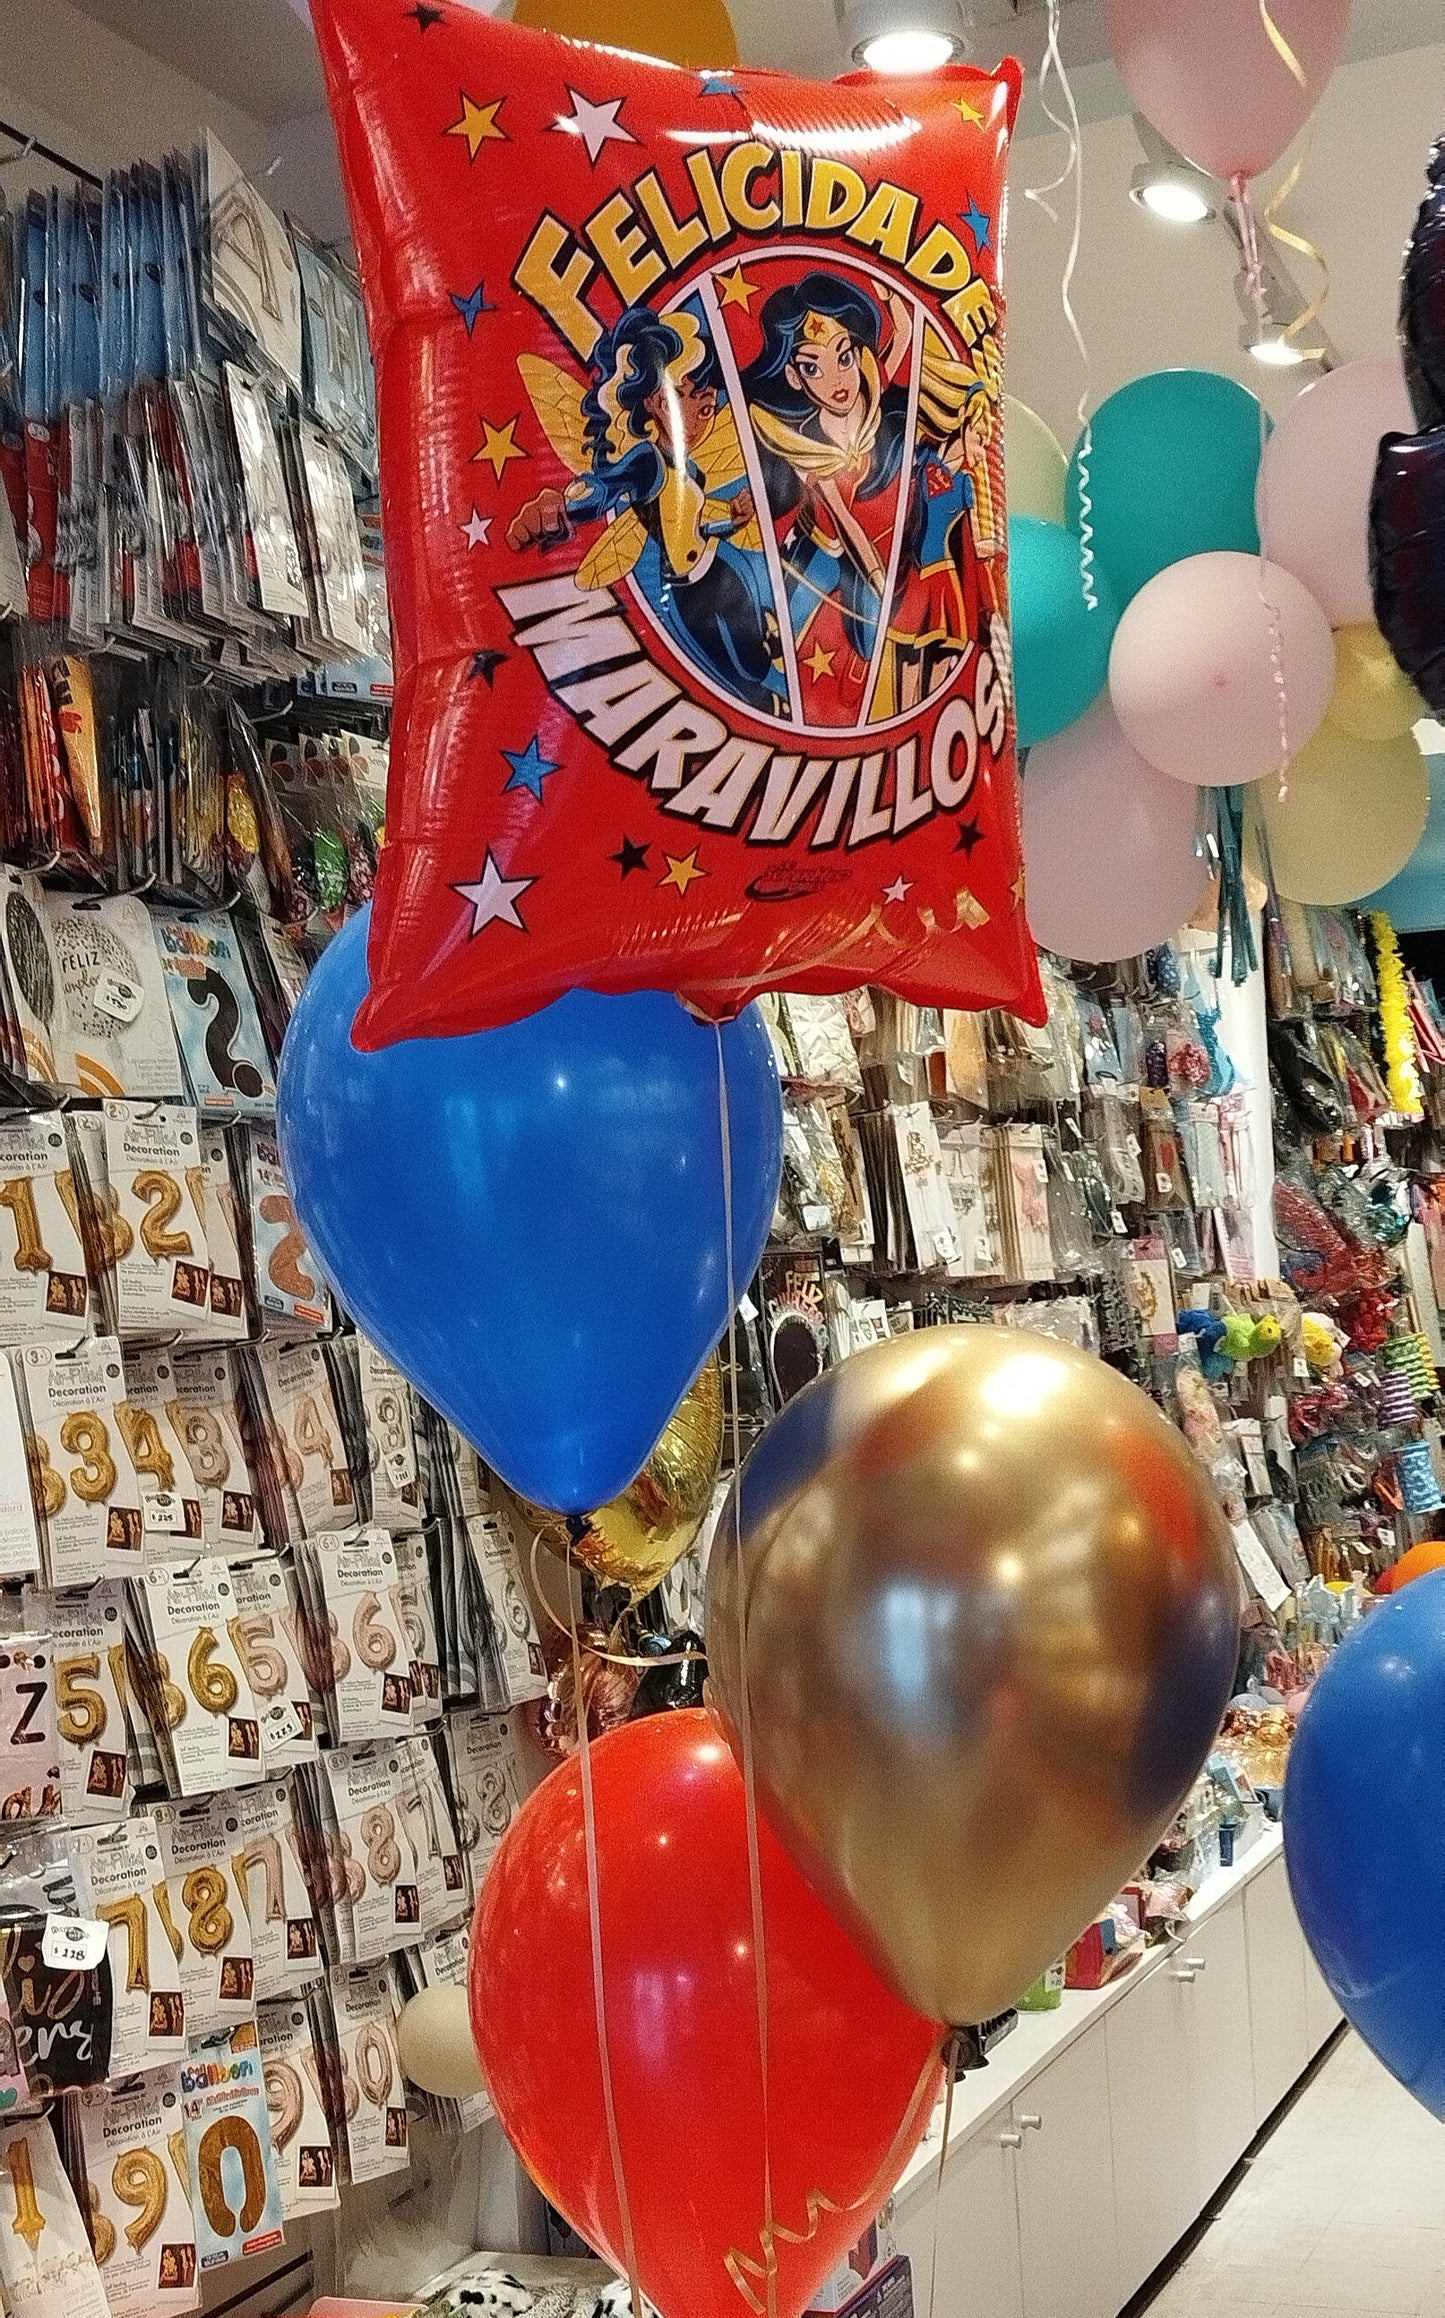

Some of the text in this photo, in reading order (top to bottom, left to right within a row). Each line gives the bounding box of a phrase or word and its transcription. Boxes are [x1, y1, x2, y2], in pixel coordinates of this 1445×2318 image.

[62, 951, 101, 974] FELIZ
[123, 1142, 180, 1157] Decoration
[131, 1167, 194, 1263] 2
[48, 1385, 107, 1398] Decoration
[60, 1409, 117, 1502] 3
[132, 1407, 175, 1490] 4
[167, 1601, 221, 1616] Decoration
[337, 1567, 384, 1578] Decoration
[188, 1625, 239, 1716] 6
[241, 1613, 288, 1699] 5
[353, 1590, 397, 1671] 6
[10, 1681, 48, 1746] Z
[54, 1652, 108, 1747] 5
[348, 1780, 391, 1797] Decoration
[91, 1867, 148, 1887] Decoration
[171, 1837, 227, 1856] Decoration
[244, 1832, 286, 1924] 7
[360, 1804, 402, 1888] 8
[95, 1893, 150, 1993] 7
[182, 1864, 234, 1955] 8
[355, 2021, 393, 2109] 0
[103, 2116, 162, 2139] Decoration
[111, 2145, 168, 2253] 9
